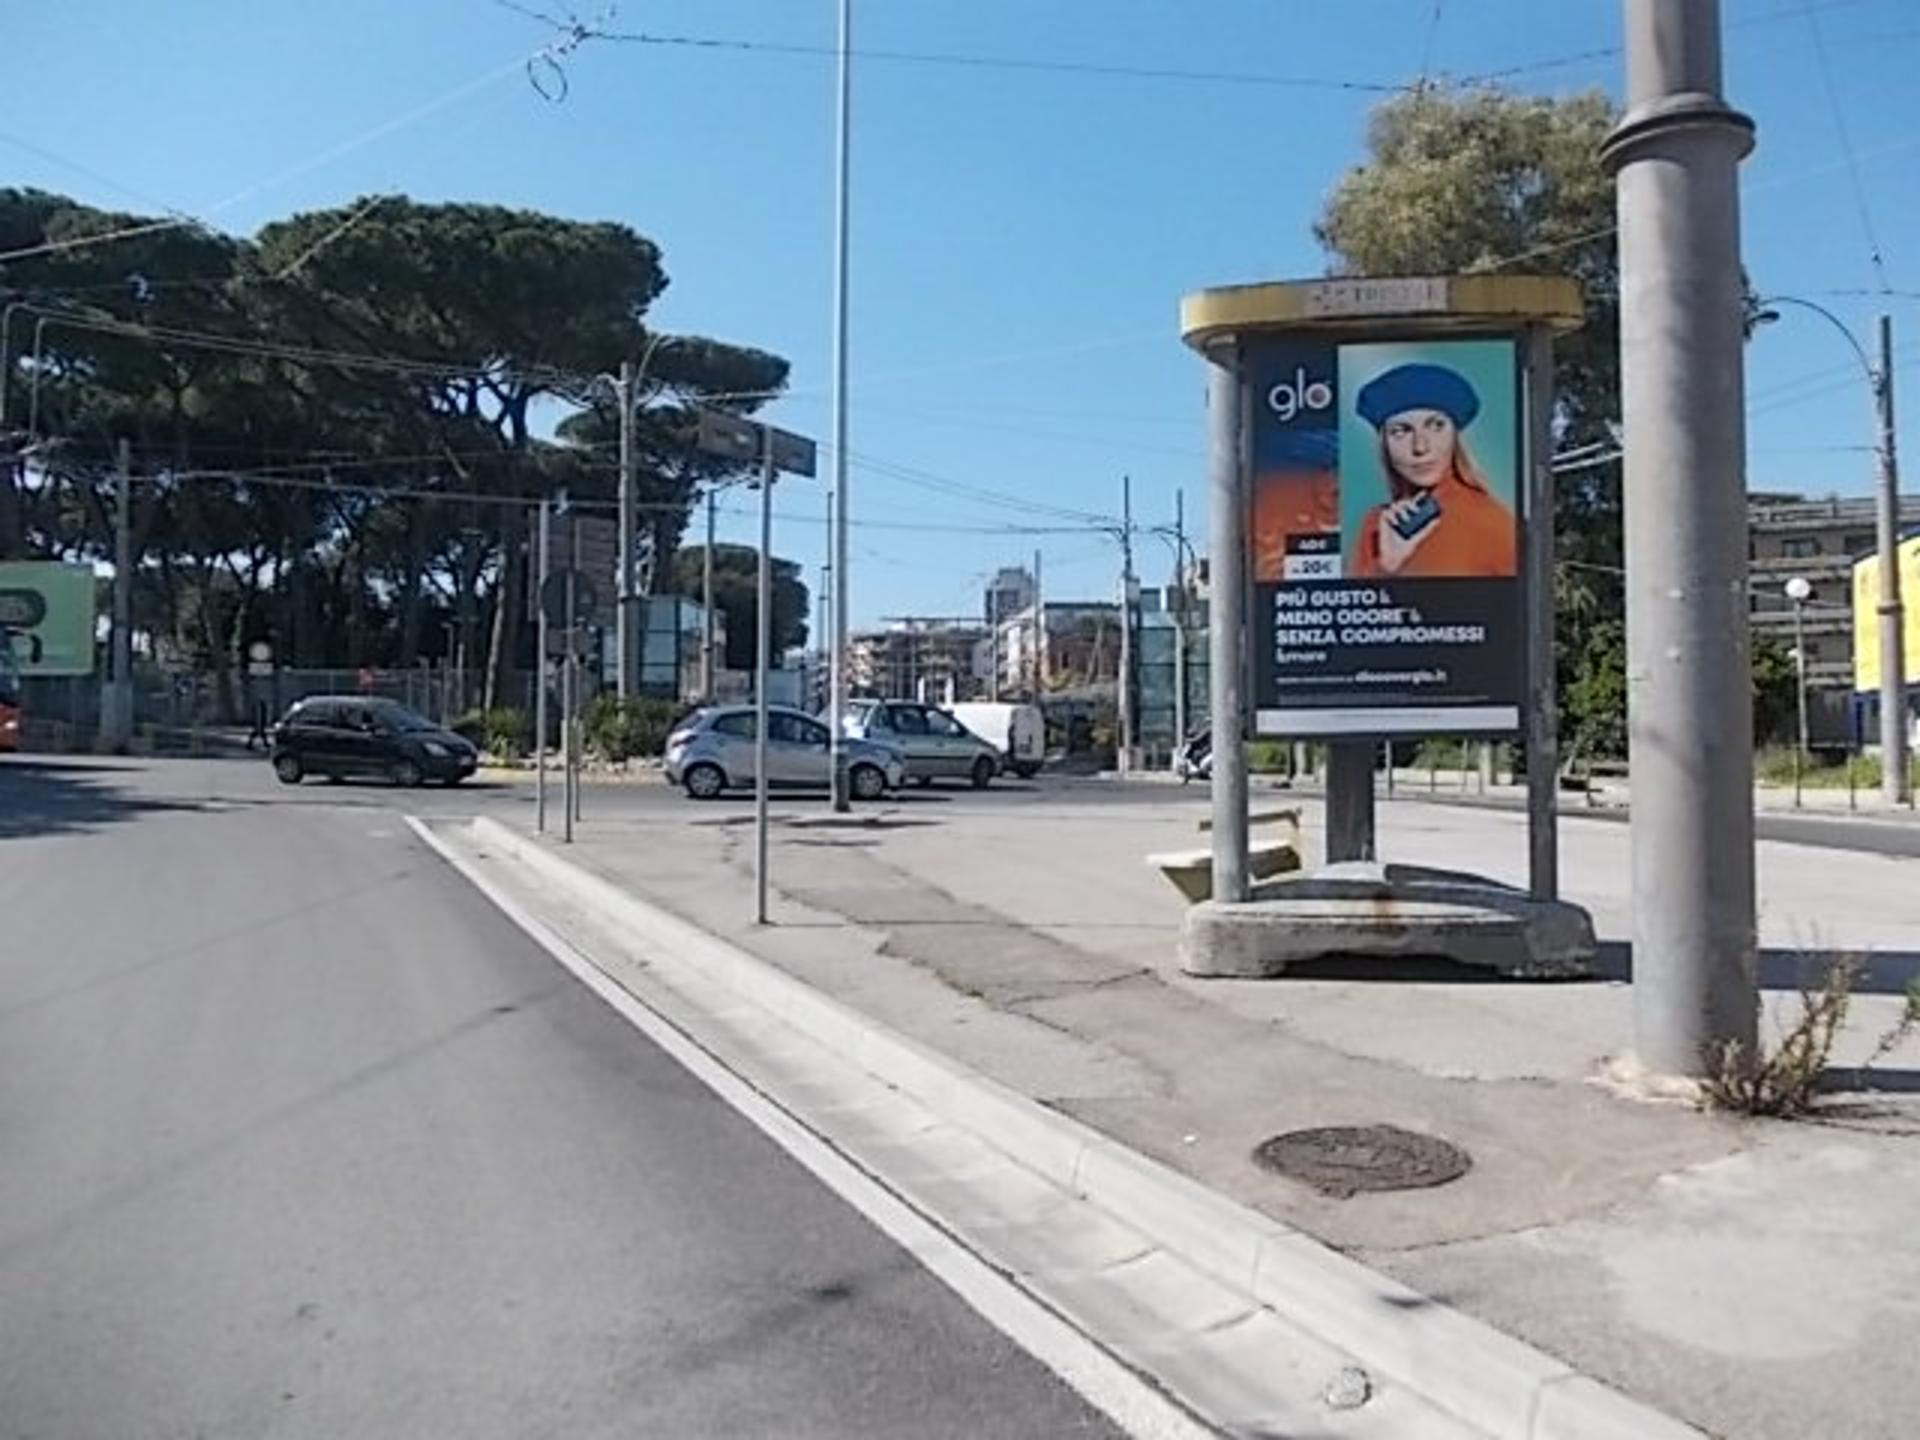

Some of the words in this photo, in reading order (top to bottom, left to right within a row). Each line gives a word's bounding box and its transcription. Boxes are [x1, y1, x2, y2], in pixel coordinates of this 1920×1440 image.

[1269, 367, 1332, 421] glo
[1276, 588, 1307, 607] PIÙ
[1310, 589, 1377, 606] GUSTO
[1276, 610, 1332, 625] MENO
[1276, 628, 1338, 645] SENZA
[1341, 626, 1485, 643] COMPROMESSI
